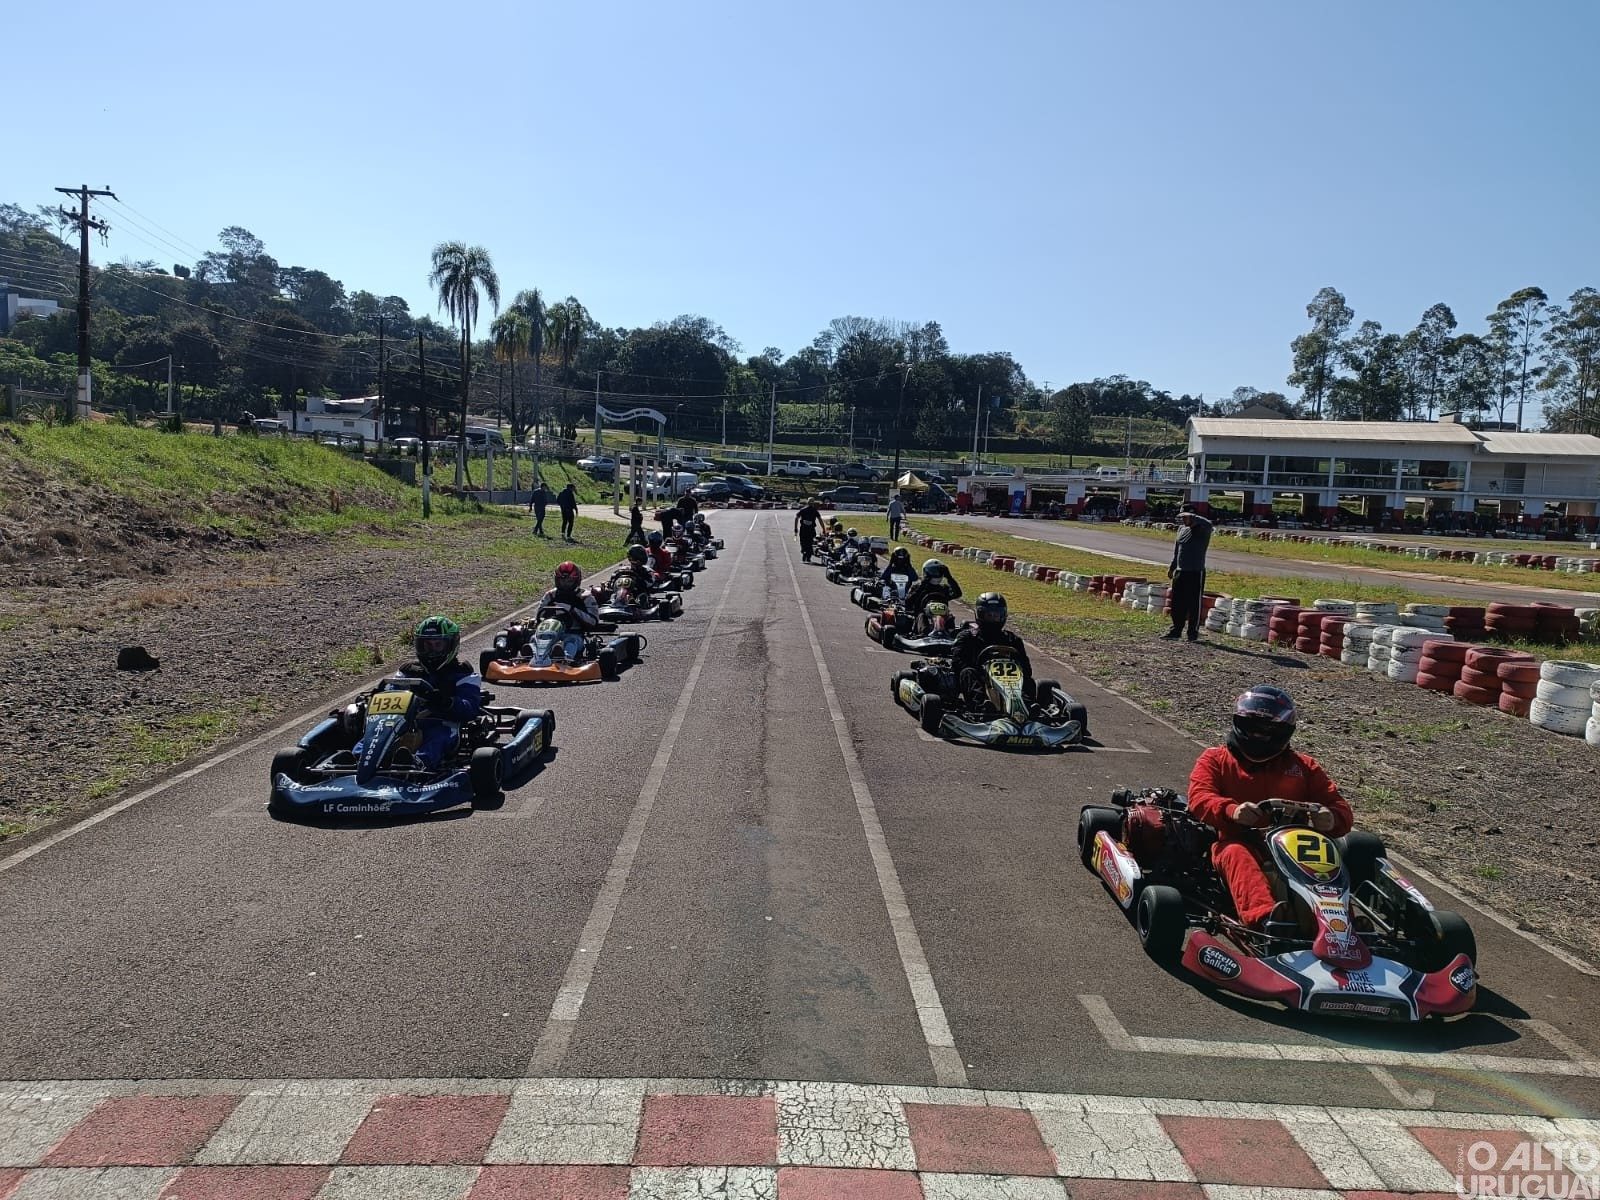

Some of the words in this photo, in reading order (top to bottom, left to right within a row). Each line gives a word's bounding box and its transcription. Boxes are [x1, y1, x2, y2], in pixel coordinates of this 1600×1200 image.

[993, 662, 1018, 677] 32
[372, 697, 402, 712] 432
[323, 803, 334, 813] LF
[1296, 835, 1335, 865] 21
[1204, 946, 1237, 969] Estrella
